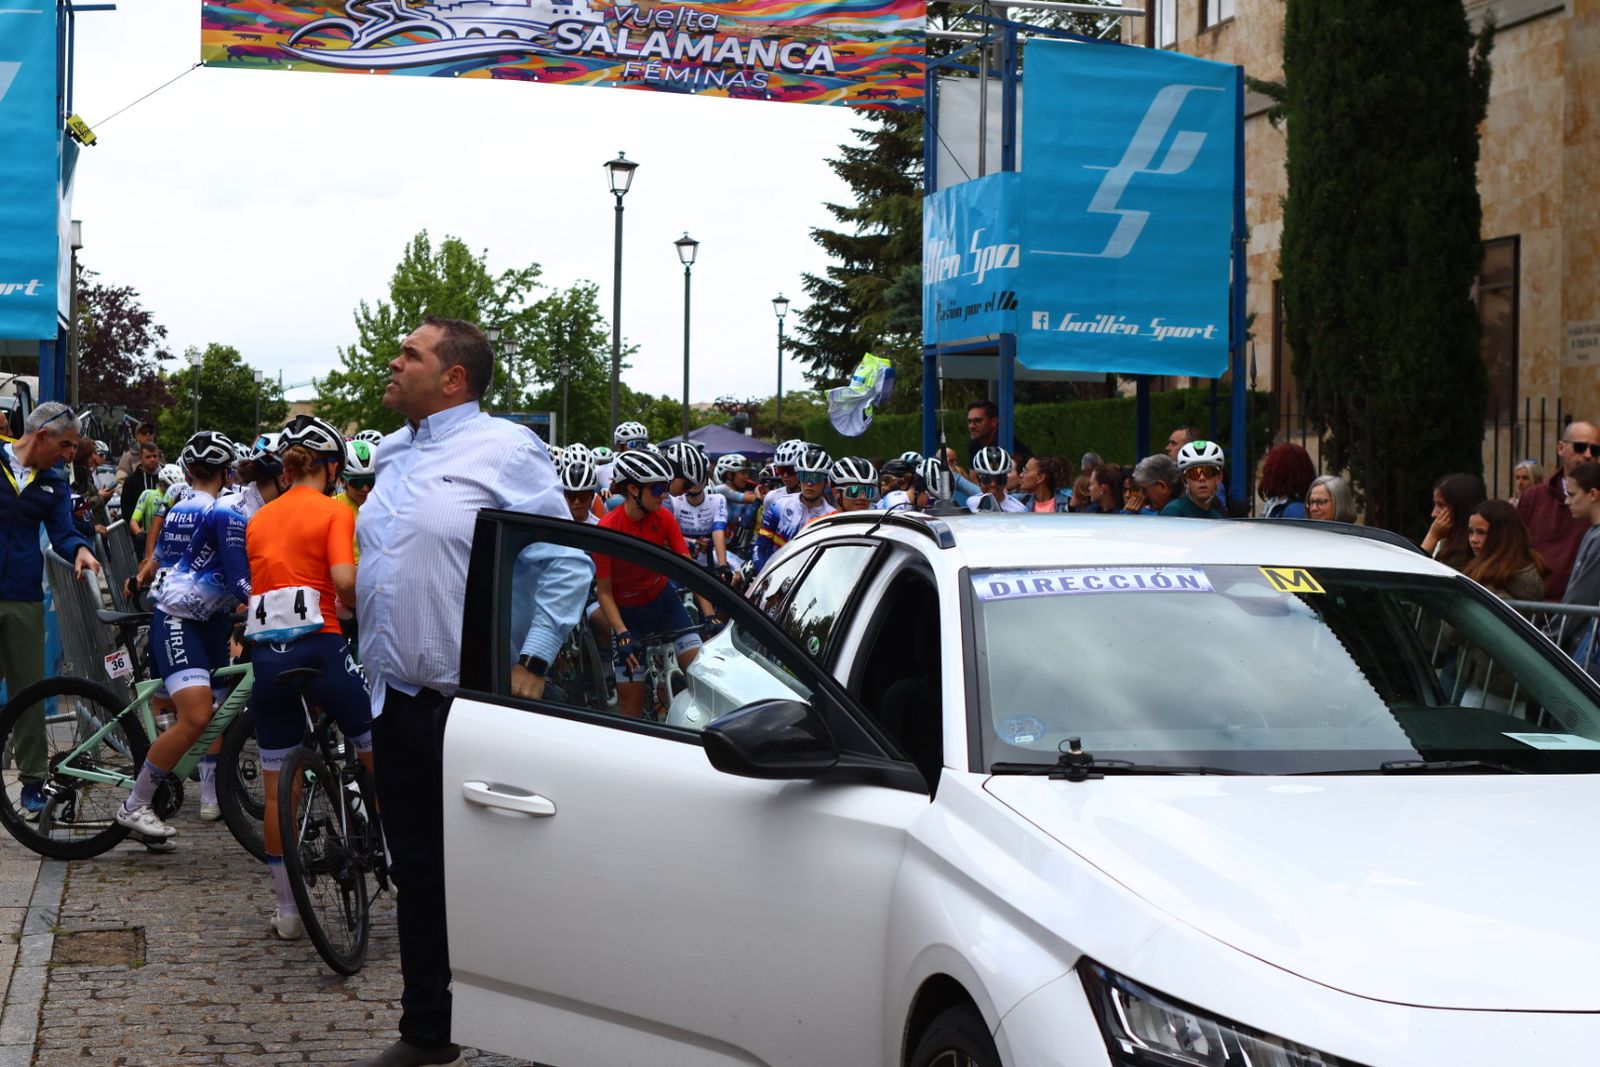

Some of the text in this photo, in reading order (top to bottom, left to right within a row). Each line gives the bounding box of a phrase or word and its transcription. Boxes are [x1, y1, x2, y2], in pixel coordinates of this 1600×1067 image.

[613, 5, 720, 30] vuelta
[555, 22, 837, 73] SALAMANCA
[623, 60, 770, 89] FÉMINAS
[1052, 313, 1140, 335] Guillén
[1140, 317, 1219, 341] Sport
[989, 571, 1201, 598] DIRECCIÓN
[1264, 569, 1319, 592] M
[256, 590, 307, 625] 4 4
[111, 658, 124, 671] 36
